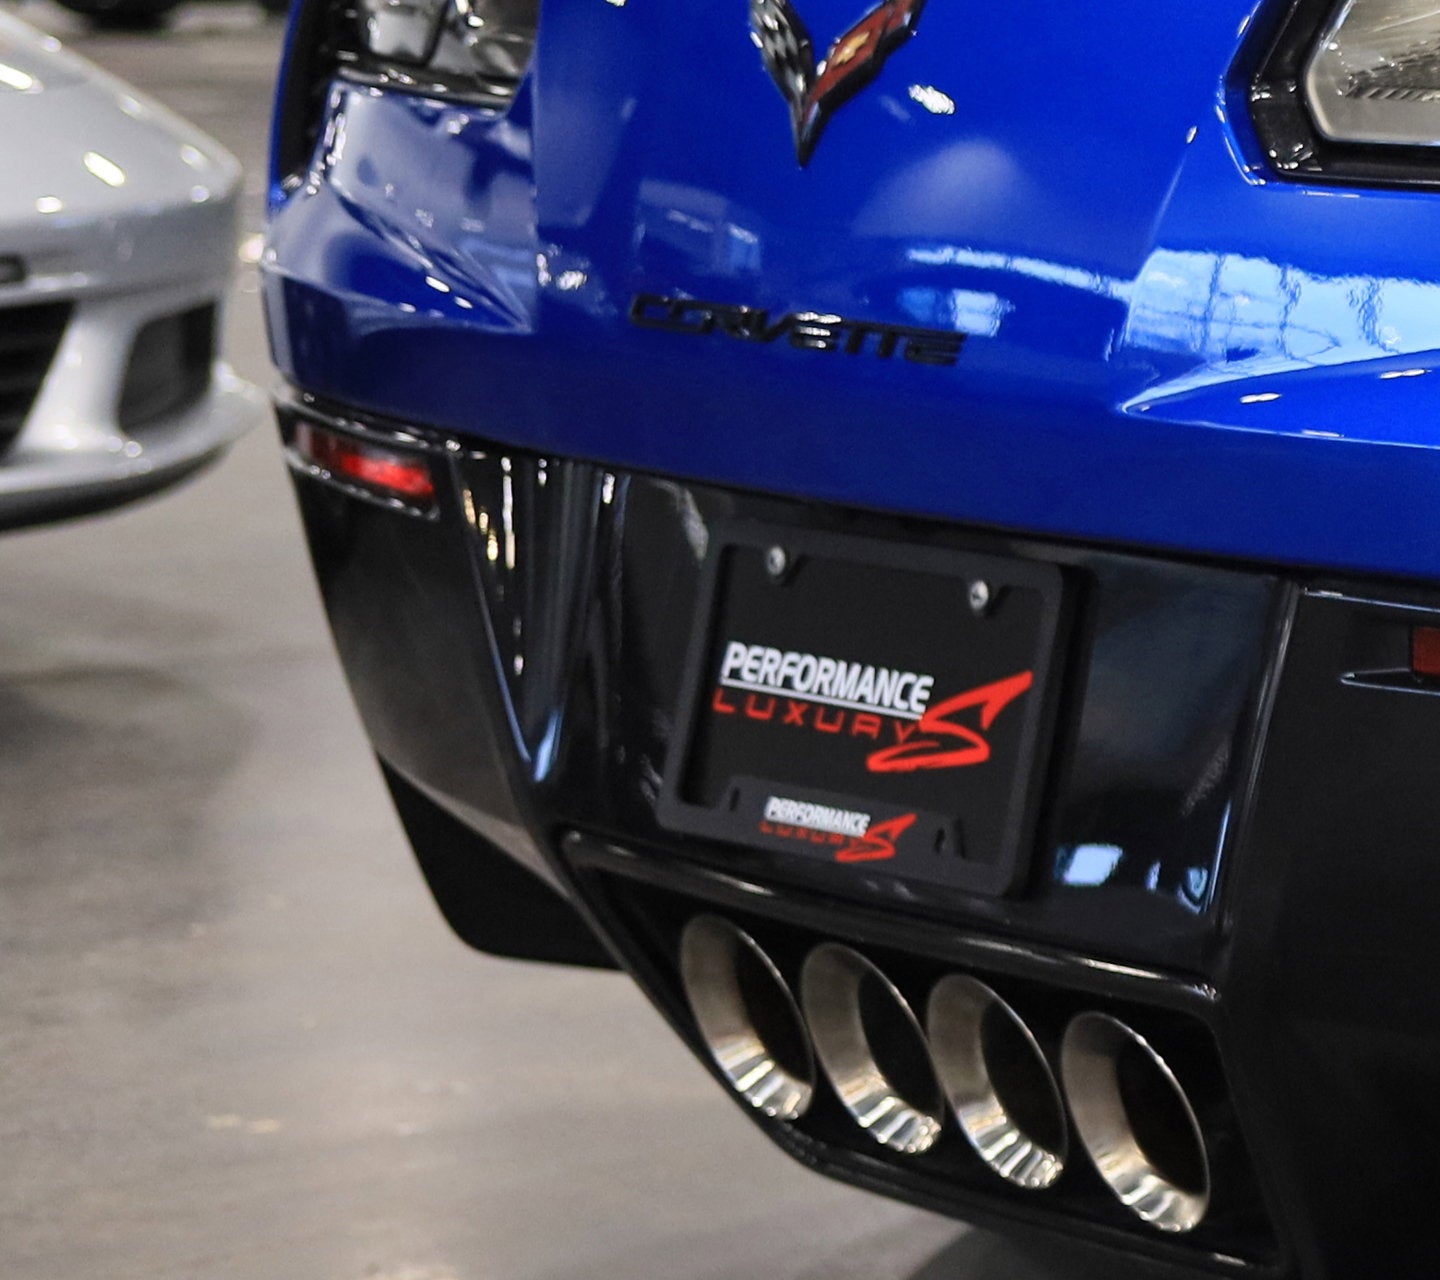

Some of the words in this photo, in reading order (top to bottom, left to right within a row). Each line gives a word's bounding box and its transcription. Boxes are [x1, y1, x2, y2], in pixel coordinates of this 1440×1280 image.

[629, 293, 968, 367] CORVETTE
[720, 640, 935, 718] PERFORMANCE
[711, 687, 922, 746] LUXURY
[764, 796, 871, 837] PERFORMANCE
